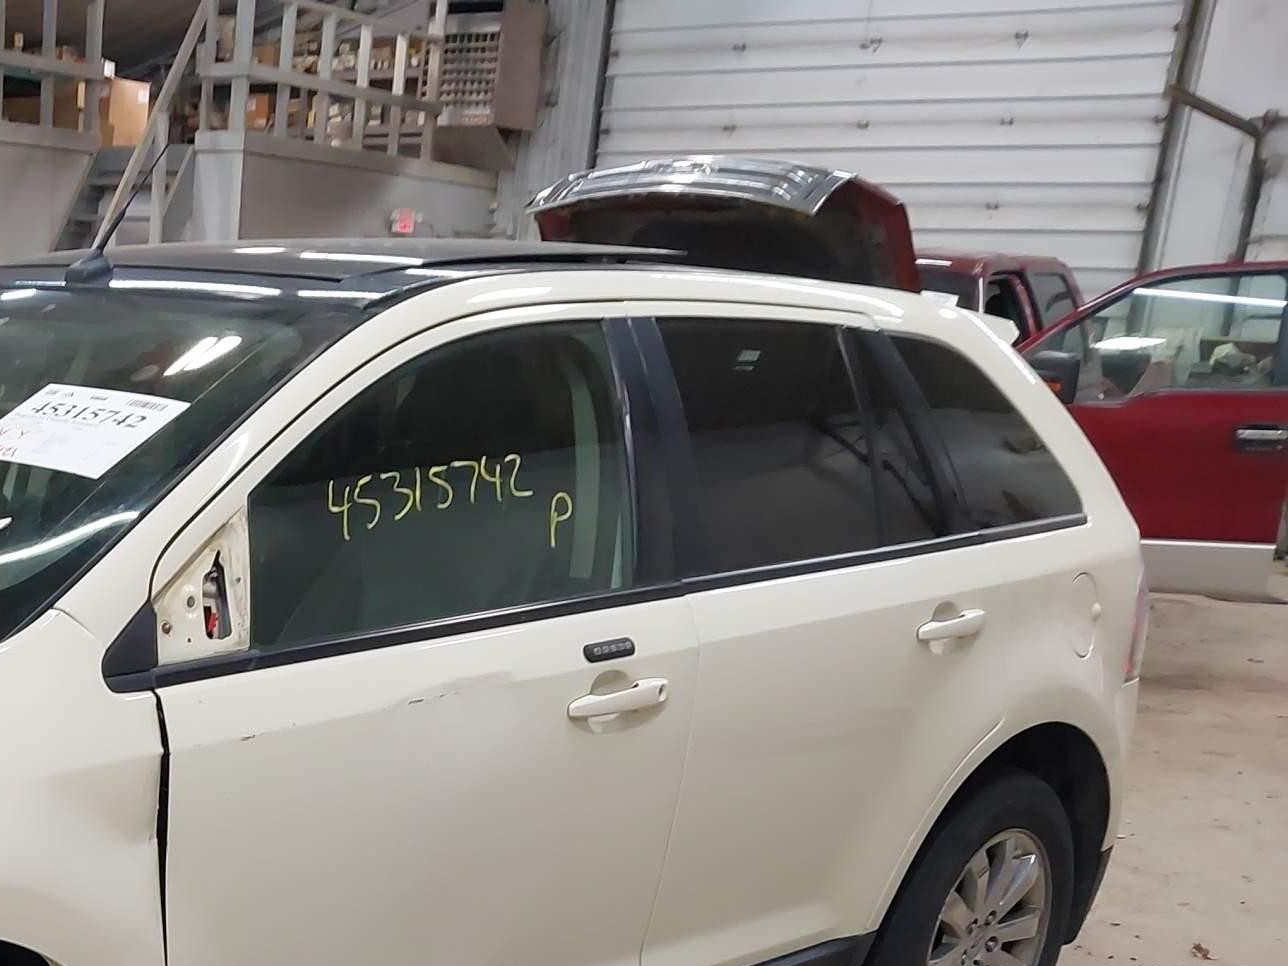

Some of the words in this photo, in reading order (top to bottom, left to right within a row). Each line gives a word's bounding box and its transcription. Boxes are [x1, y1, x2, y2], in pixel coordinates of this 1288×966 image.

[32, 401, 147, 429] 45315742
[327, 453, 534, 541] 45315742
[550, 491, 573, 548] P
